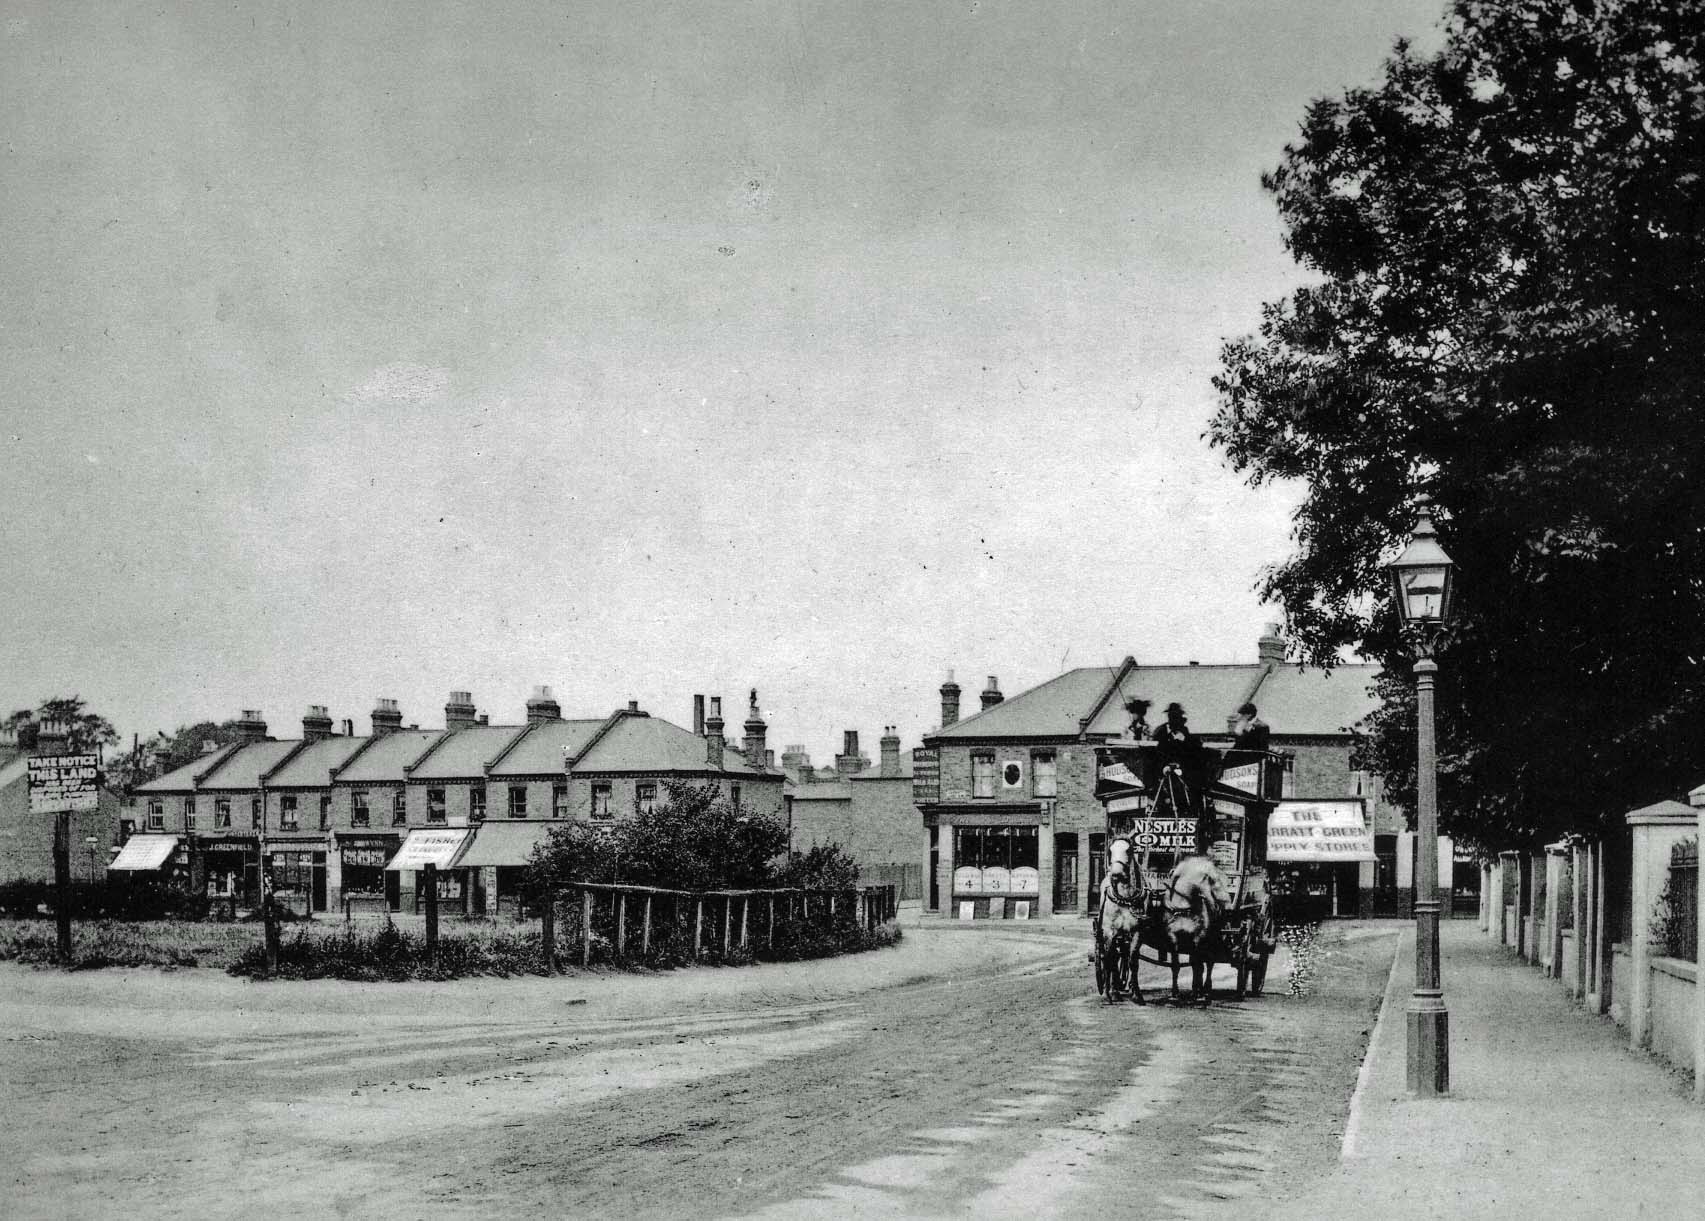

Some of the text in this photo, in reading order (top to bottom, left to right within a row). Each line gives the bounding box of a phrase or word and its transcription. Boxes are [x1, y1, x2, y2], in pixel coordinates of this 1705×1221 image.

[29, 755, 96, 768] TAKE NOTICE
[29, 767, 97, 781] THIS LAND
[1291, 811, 1322, 821] THE
[1322, 826, 1366, 837] GREEN
[1159, 835, 1196, 847] MILK
[965, 880, 973, 889] 4
